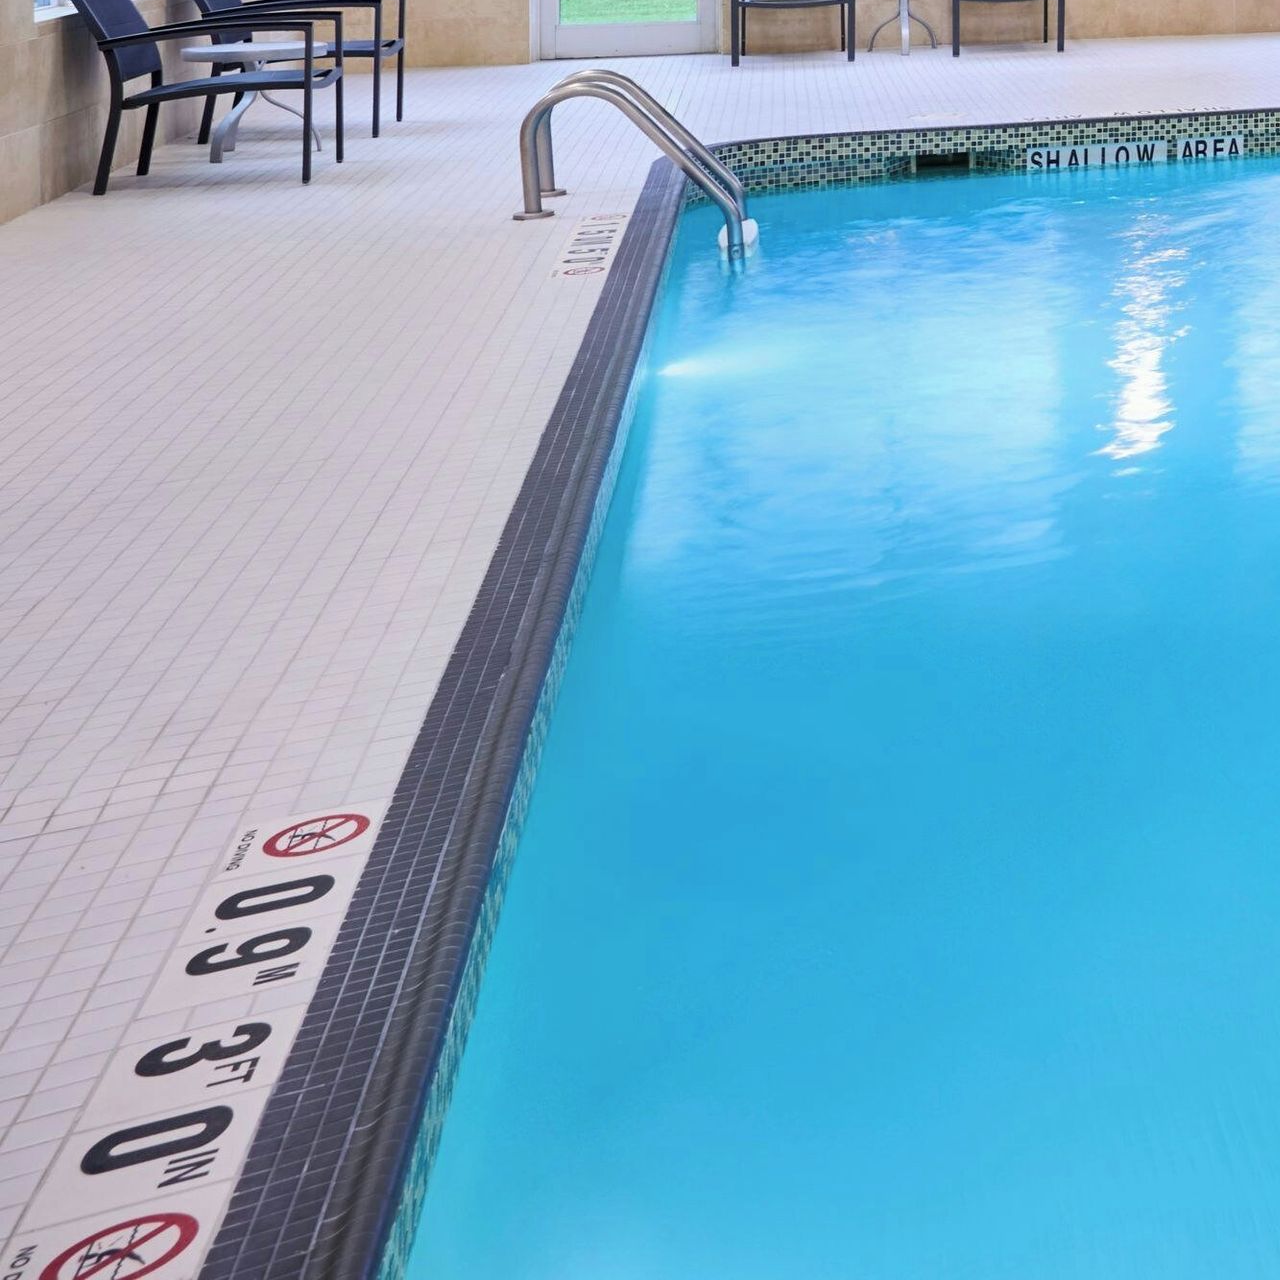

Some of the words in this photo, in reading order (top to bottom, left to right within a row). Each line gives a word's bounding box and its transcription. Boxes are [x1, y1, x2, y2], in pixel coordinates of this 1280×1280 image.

[1030, 143, 1156, 169] SHALLOW
[1181, 137, 1240, 159] AREA
[241, 829, 258, 842] NO
[225, 842, 251, 871] DIVING
[10, 1245, 38, 1269] NO
